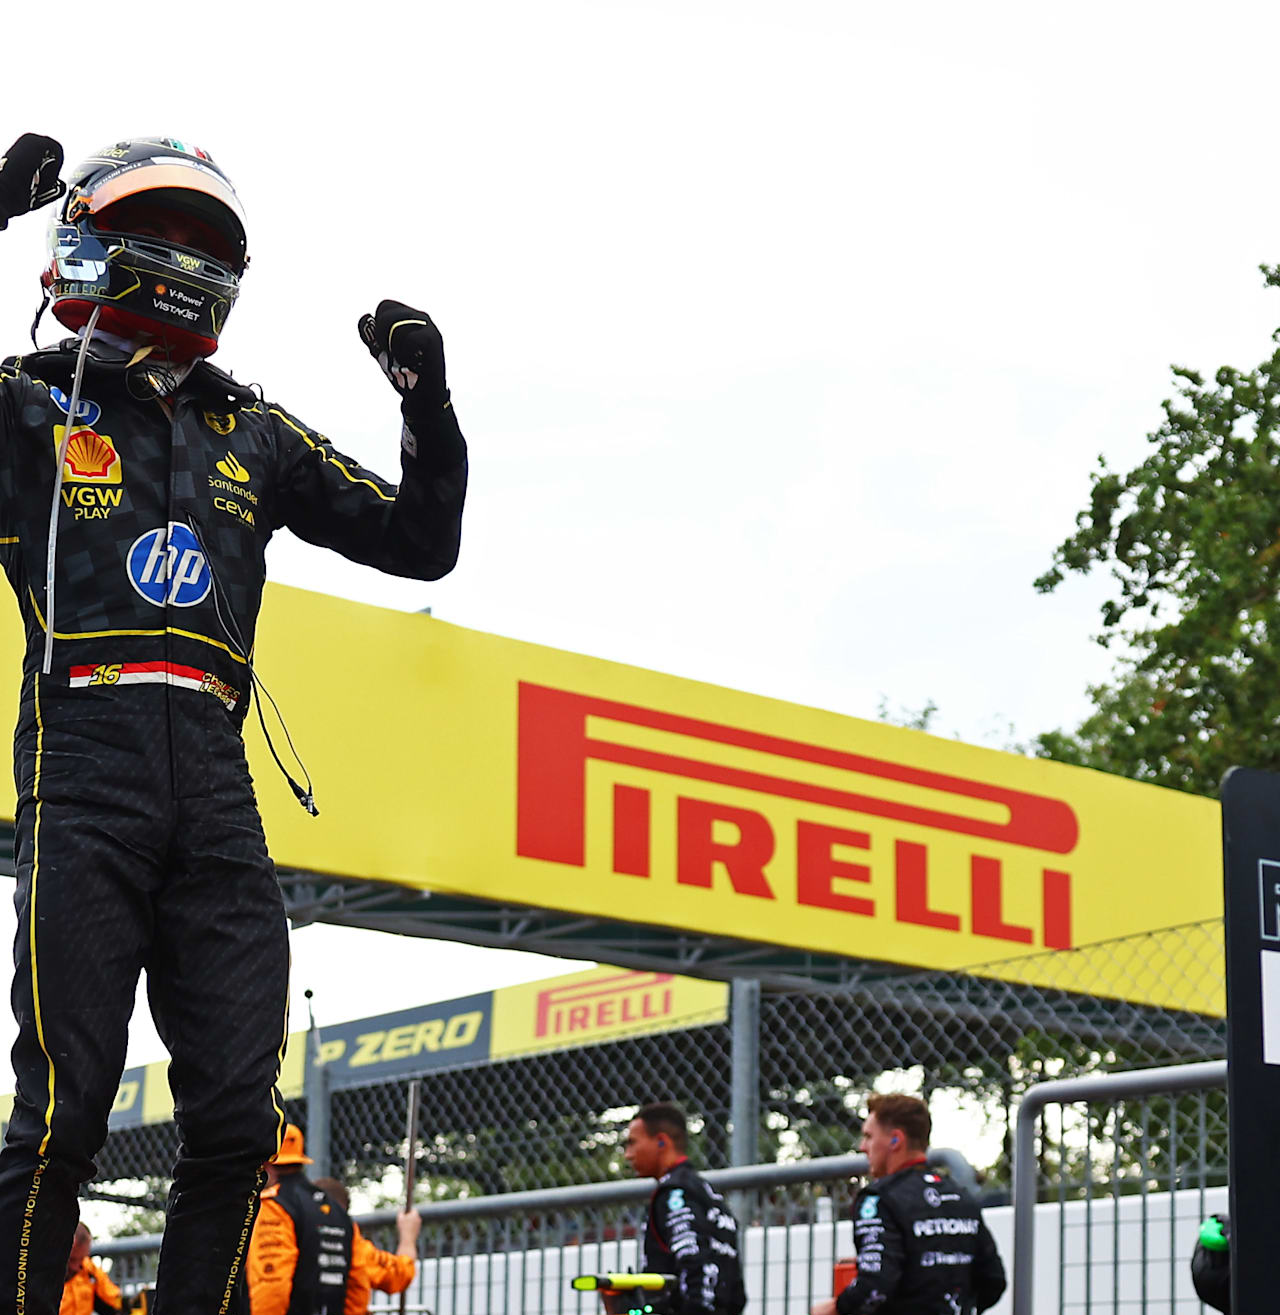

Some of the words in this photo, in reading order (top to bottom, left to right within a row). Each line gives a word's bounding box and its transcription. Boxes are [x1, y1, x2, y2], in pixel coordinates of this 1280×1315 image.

[176, 254, 201, 268] VGW
[152, 298, 200, 322] VISTAJET
[61, 487, 123, 507] VGW
[208, 475, 258, 506] Santander
[74, 508, 111, 520] PLAY
[137, 526, 207, 606] hp
[89, 664, 122, 686] 16
[516, 680, 1080, 951] PIRELLI
[535, 970, 675, 1038] PIRELLI
[313, 1040, 346, 1067] P
[348, 1011, 483, 1067] ZERO
[20, 1219, 33, 1247] AND
[237, 1228, 249, 1255] AND
